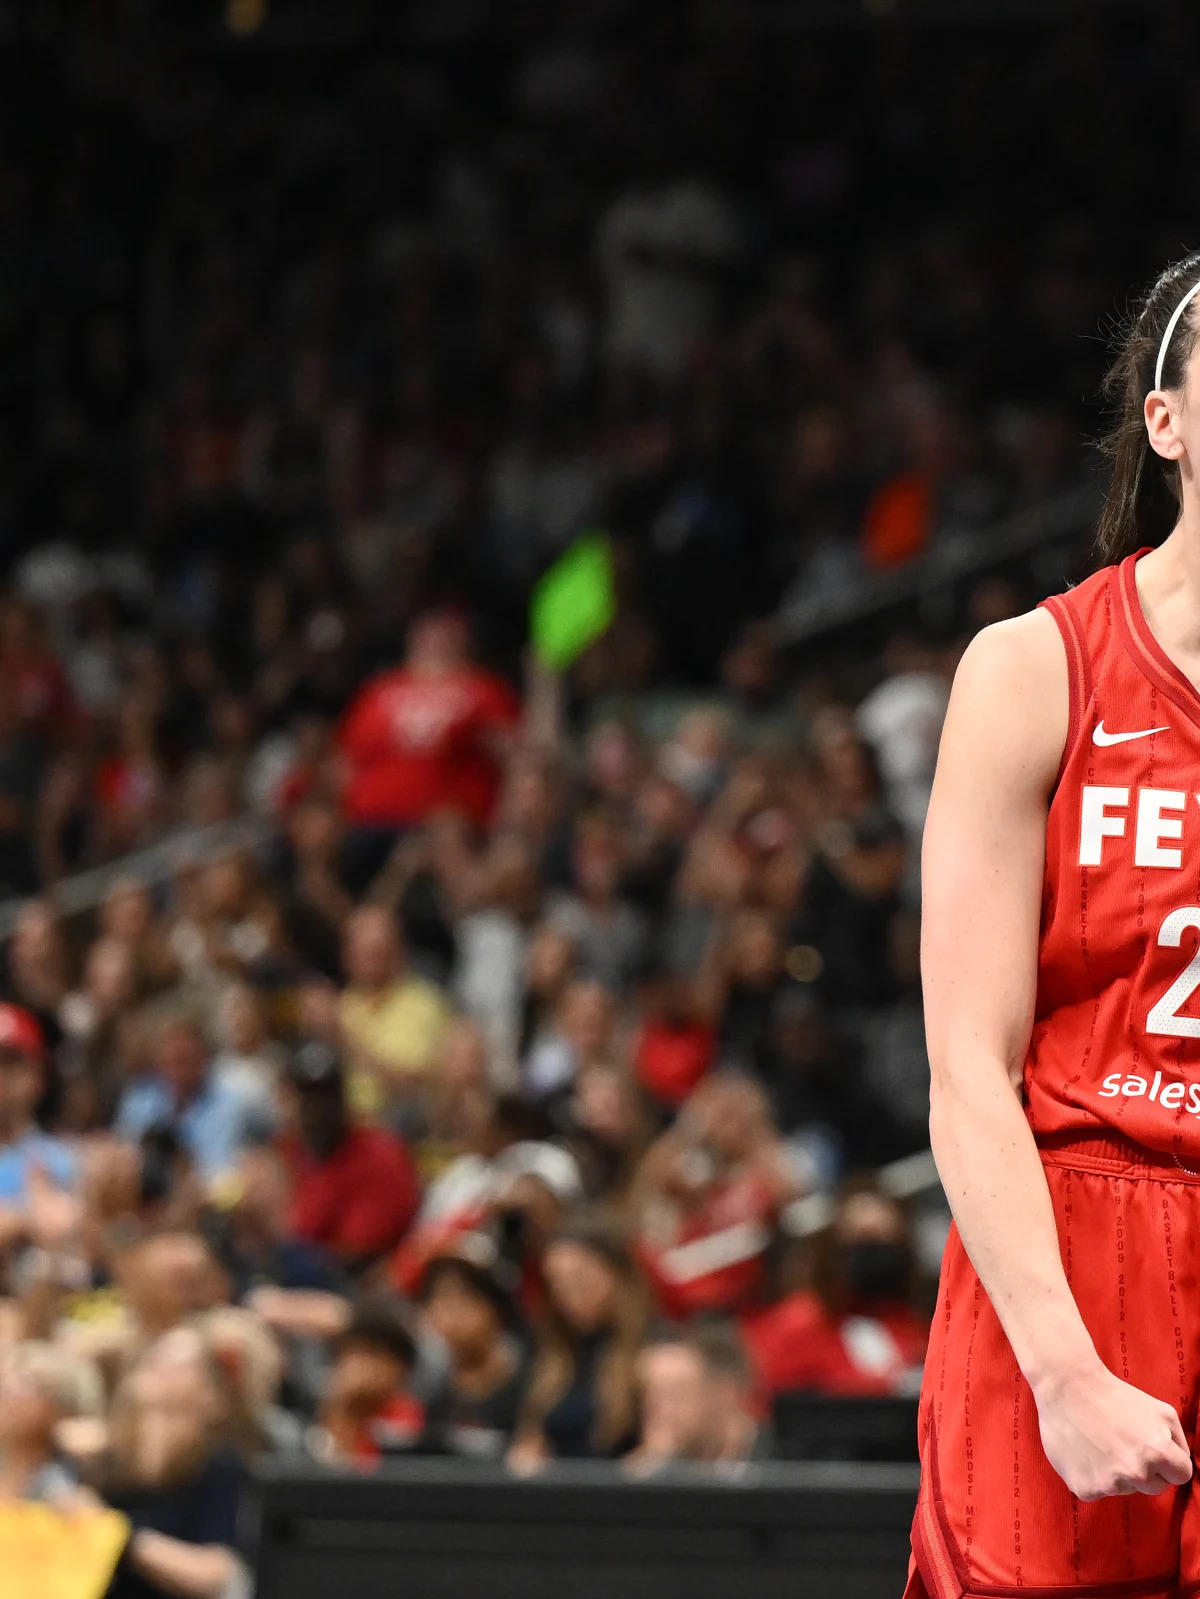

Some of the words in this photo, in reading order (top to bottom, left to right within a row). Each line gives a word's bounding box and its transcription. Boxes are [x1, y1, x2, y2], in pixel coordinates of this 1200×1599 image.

[1162, 1200, 1178, 1317] BASKETBALL
[1174, 1327, 1187, 1384] CHOSE
[965, 1437, 974, 1496] CHOSE
